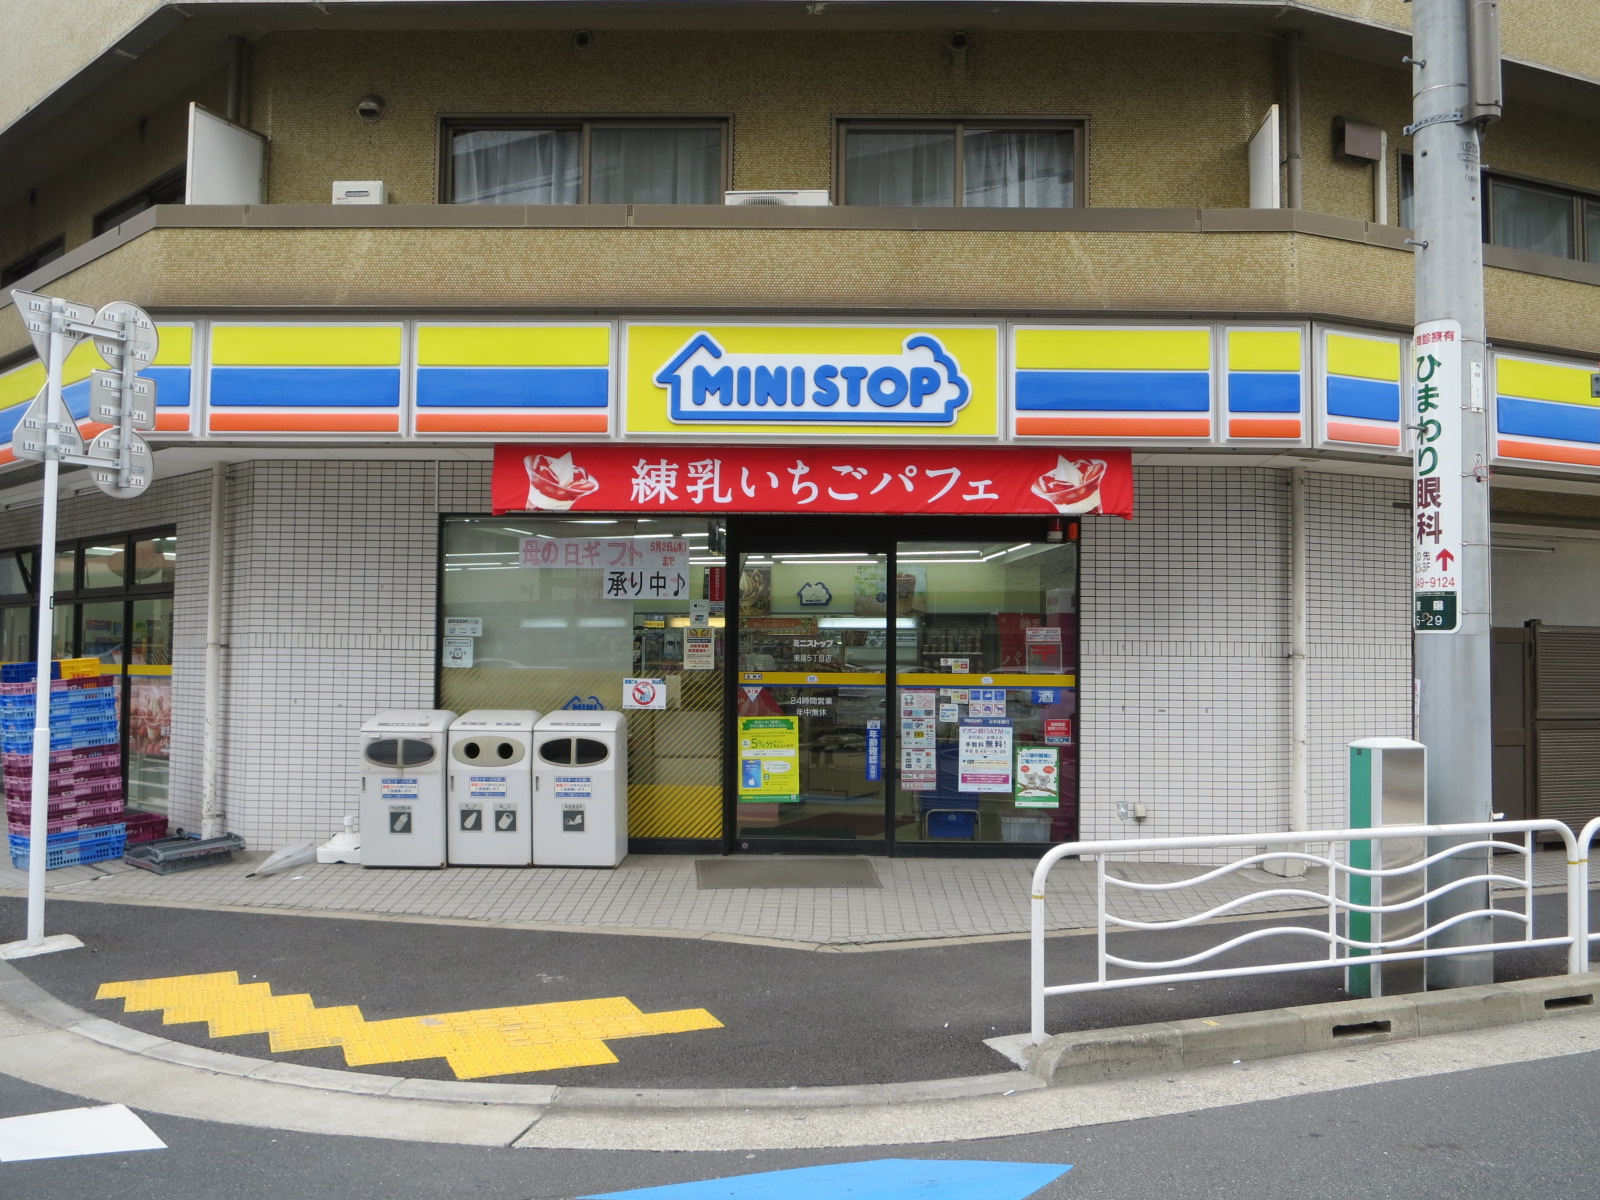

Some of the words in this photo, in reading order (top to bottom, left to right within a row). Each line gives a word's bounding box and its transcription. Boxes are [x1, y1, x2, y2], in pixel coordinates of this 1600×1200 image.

[692, 364, 941, 407] MINISTOP
[1416, 354, 1442, 546] ひまわり眼科
[630, 458, 999, 505] 練乳いちごパフェ
[522, 539, 643, 566] 母の日ギフト
[662, 555, 676, 567] まで
[790, 696, 833, 705] 24時間営業
[1038, 690, 1054, 703] 酒
[795, 708, 827, 717] 年中無休
